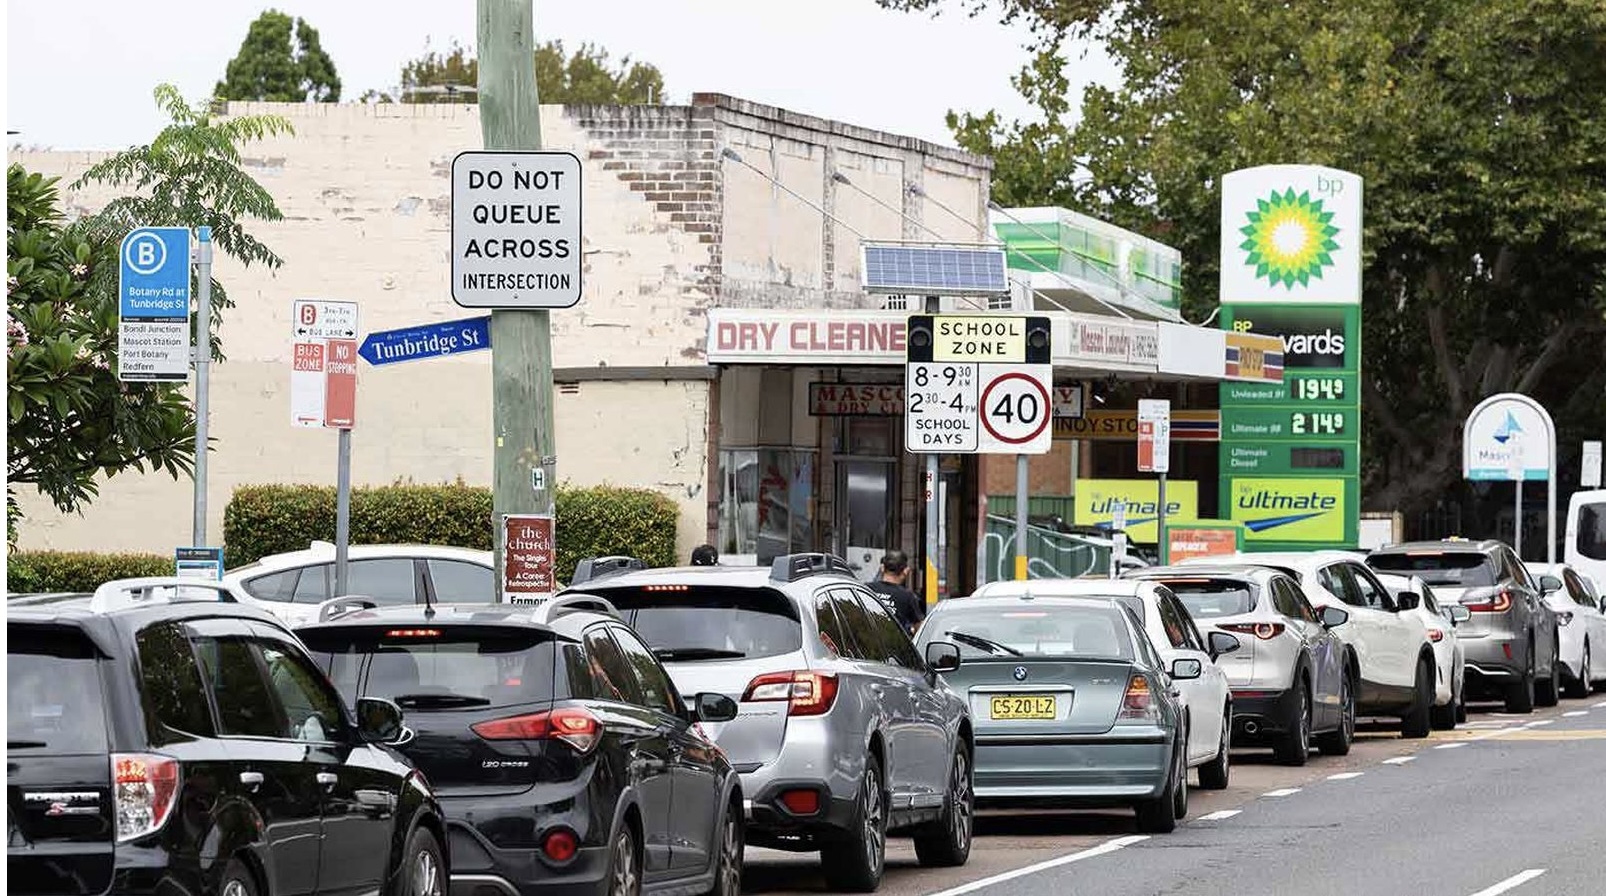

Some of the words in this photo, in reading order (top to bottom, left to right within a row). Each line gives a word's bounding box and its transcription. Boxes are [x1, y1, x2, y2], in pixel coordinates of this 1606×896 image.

[469, 170, 503, 189] DO
[514, 170, 564, 190] NOT
[1318, 174, 1344, 198] bp
[473, 205, 561, 224] QUEUE
[138, 242, 155, 265] B
[464, 239, 569, 258] ACROSS
[463, 274, 570, 290] INTERSECTION
[129, 287, 161, 298] Botany
[163, 287, 174, 296] Rd
[176, 288, 185, 296] at
[130, 299, 174, 310] Tunbridge
[175, 299, 185, 309] St
[301, 305, 316, 325] B
[123, 325, 147, 333] Bondi
[148, 325, 182, 334] Junction
[309, 328, 322, 336] BUS
[717, 322, 780, 351] DRY
[789, 322, 906, 351] CLEANE
[940, 323, 1019, 336] SCHOOL
[123, 337, 152, 346] Mascot
[152, 337, 182, 346] Station
[371, 334, 458, 360] Tunbridge
[461, 328, 480, 347] St
[952, 342, 1007, 355] ZONE
[123, 350, 140, 358] Port
[141, 350, 168, 359] Botany
[297, 346, 320, 357] BUS
[336, 346, 349, 360] NO
[123, 363, 155, 371] Redfern
[295, 359, 321, 371] ZONE
[992, 393, 1038, 424] 40
[915, 419, 970, 430] SCHOOL
[1055, 418, 1099, 433] INOY
[1103, 418, 1138, 433] STO
[923, 434, 963, 444] DAYS
[534, 472, 542, 487] H
[1091, 496, 1181, 515] ultimae
[1239, 491, 1336, 509] ultimate
[521, 526, 543, 539] the
[508, 538, 550, 550] church
[994, 699, 1011, 714] CS
[1015, 699, 1032, 714] 20
[1036, 699, 1053, 714] LZ
